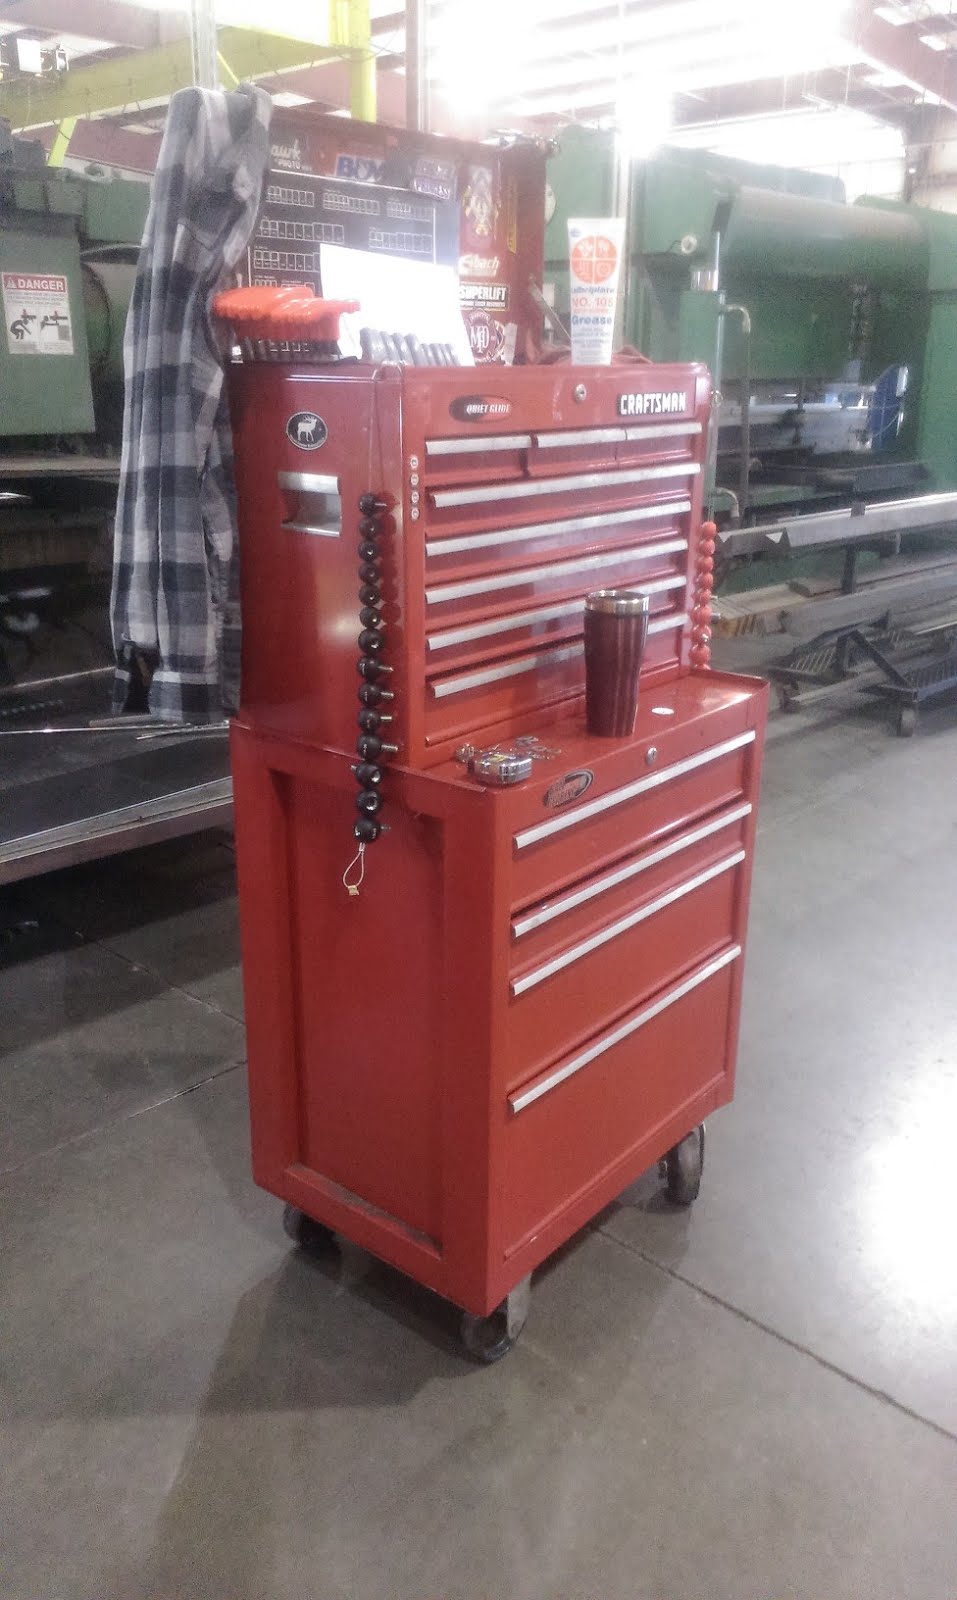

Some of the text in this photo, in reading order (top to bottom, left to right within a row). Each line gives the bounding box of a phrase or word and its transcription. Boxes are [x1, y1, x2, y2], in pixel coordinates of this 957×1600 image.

[17, 278, 64, 291] DANGER
[457, 285, 506, 300] SUPERLIFT
[572, 315, 612, 325] Grease
[466, 404, 510, 415] QUIET GLIDE
[620, 392, 687, 415] CRAFTSMAN
